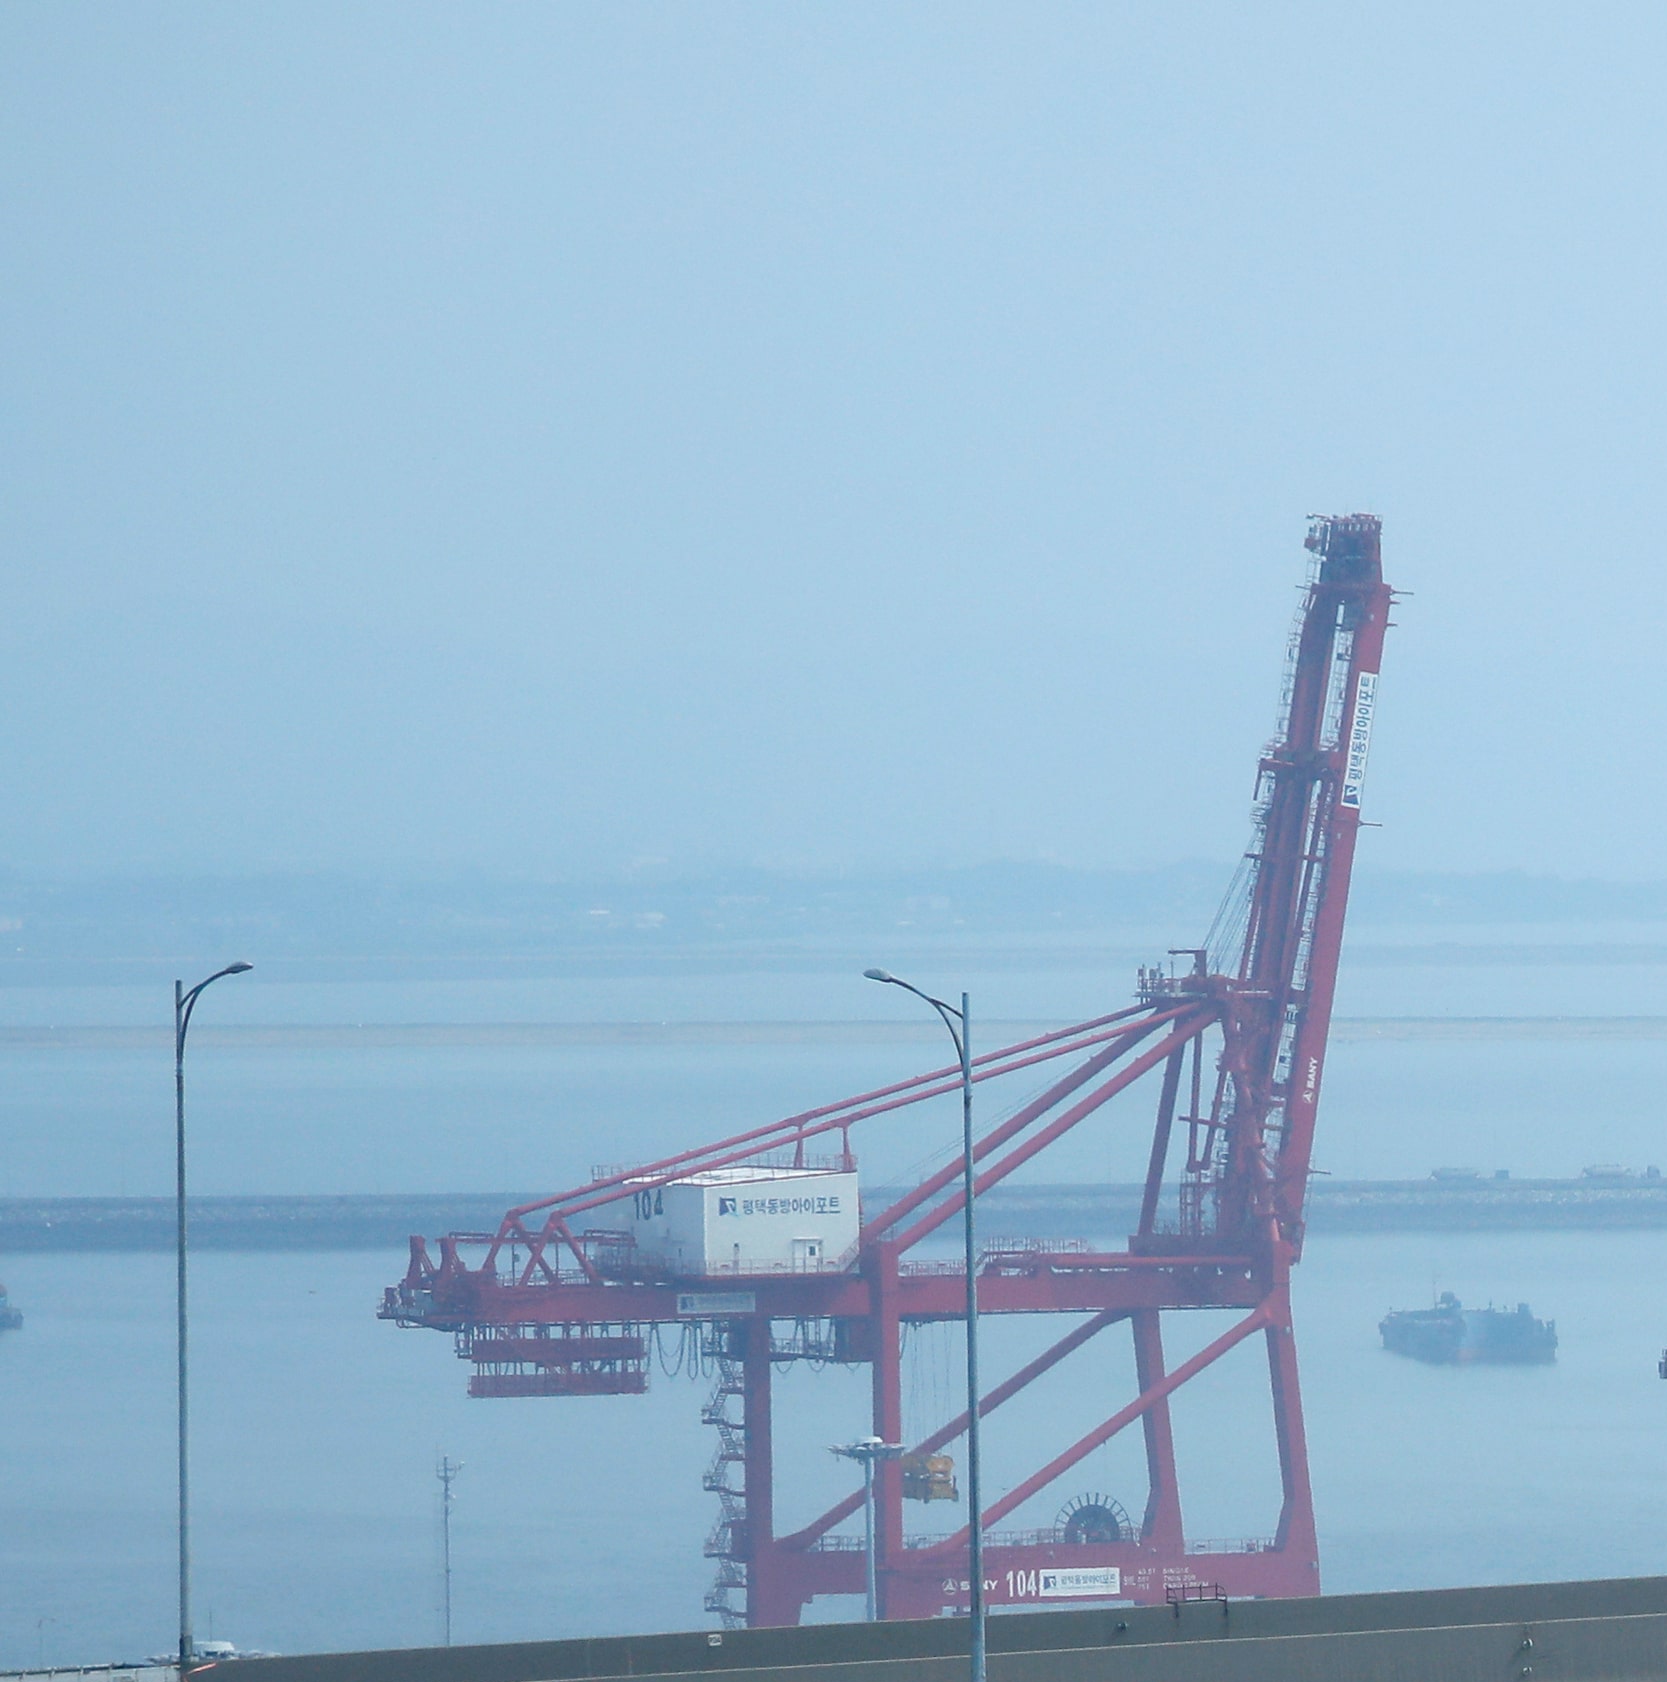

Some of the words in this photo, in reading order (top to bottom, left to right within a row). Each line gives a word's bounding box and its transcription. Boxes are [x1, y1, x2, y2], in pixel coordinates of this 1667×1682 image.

[742, 1197, 841, 1215] 평택동방아이포트
[959, 1578, 999, 1592] SNY
[1005, 1570, 1038, 1598] 104
